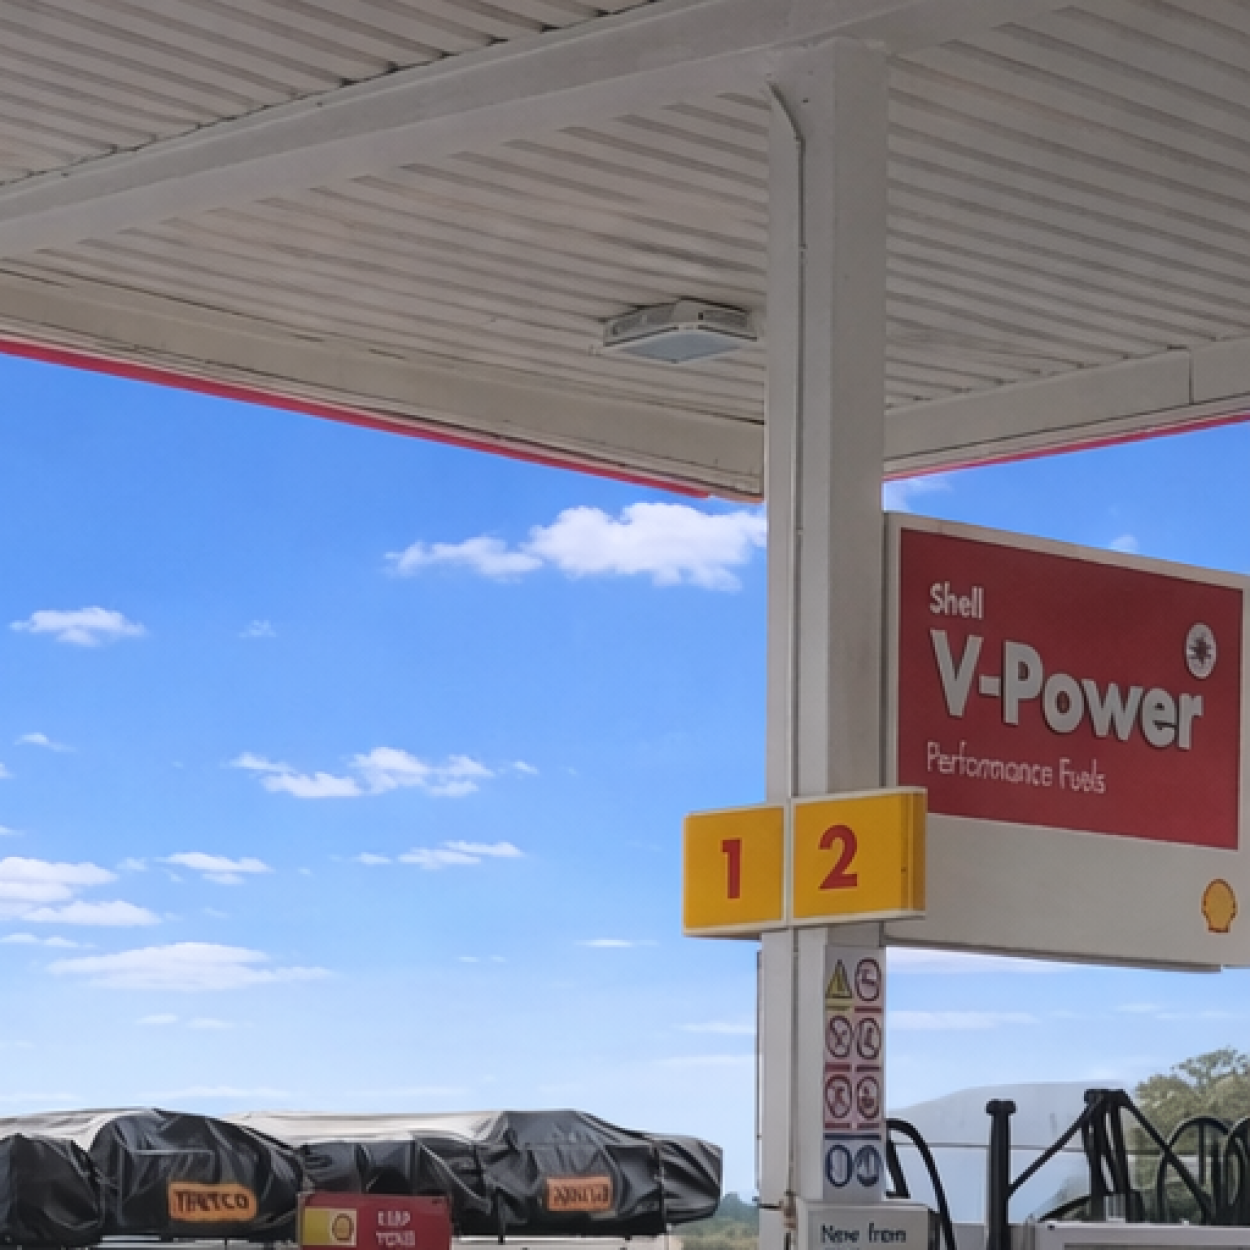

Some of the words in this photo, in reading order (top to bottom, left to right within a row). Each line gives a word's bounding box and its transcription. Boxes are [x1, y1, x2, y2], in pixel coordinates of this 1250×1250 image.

[929, 581, 984, 620] Shell
[929, 628, 1204, 750] V-Power
[927, 740, 1053, 787] Performance
[1059, 757, 1106, 794] Fuels
[720, 838, 742, 899] 1
[818, 824, 858, 890] 2
